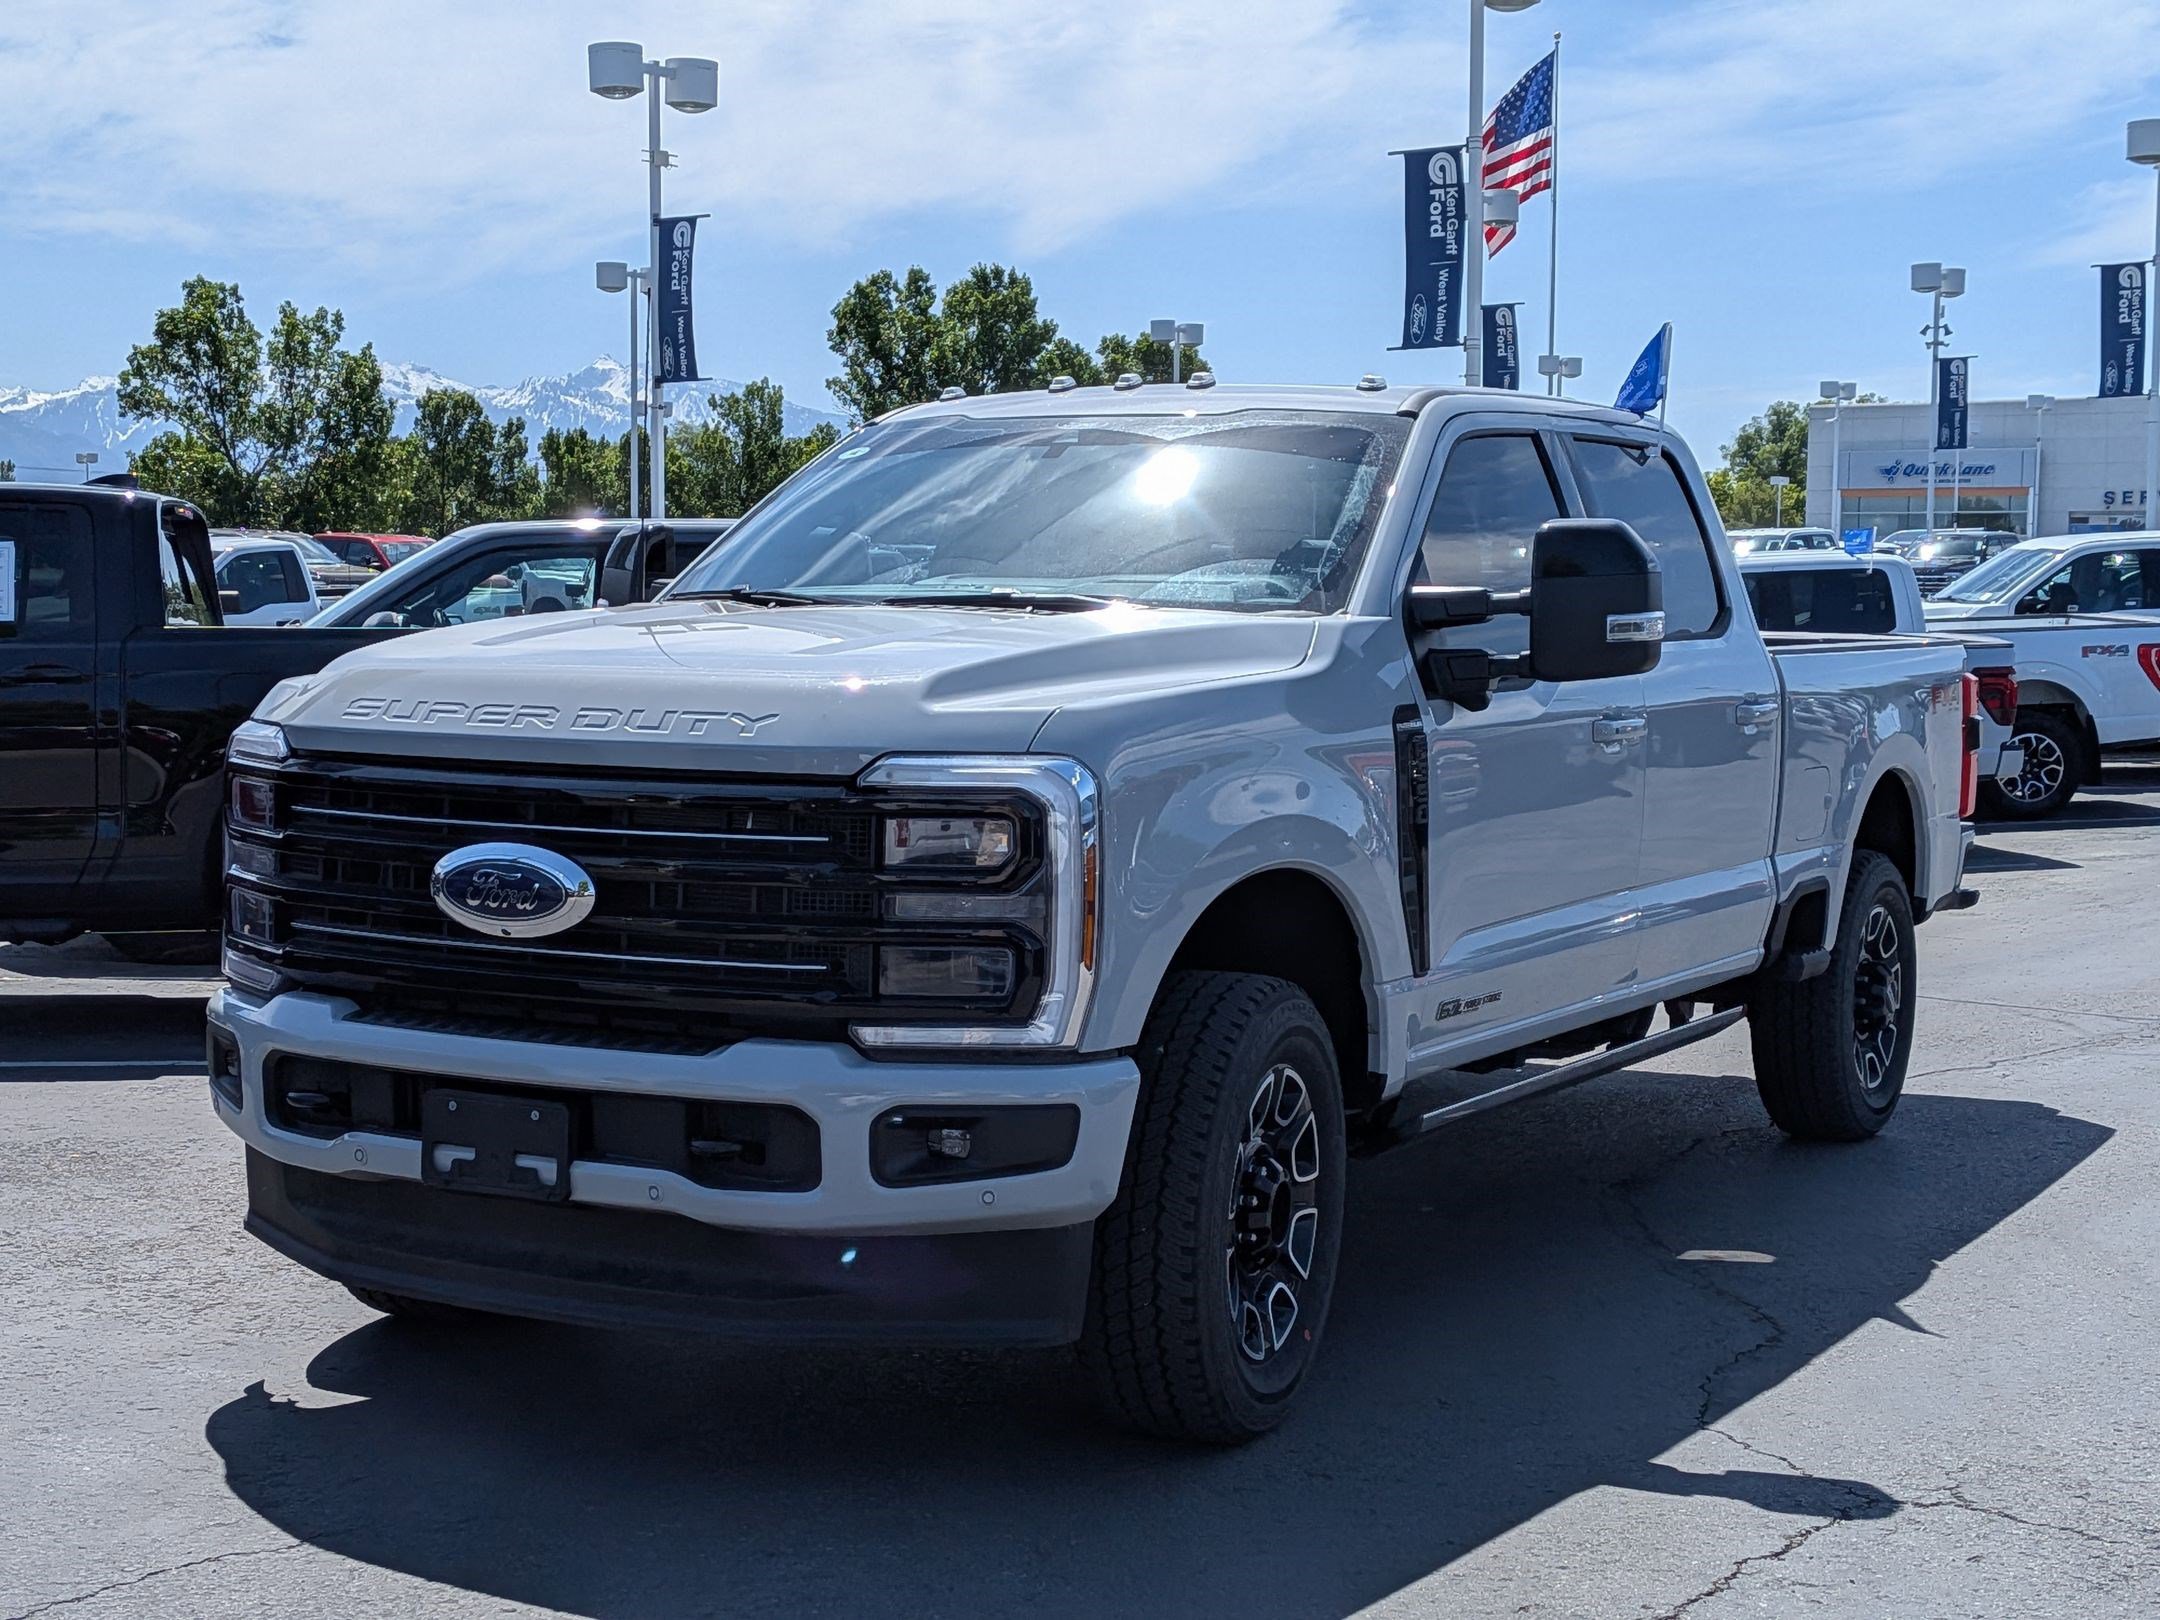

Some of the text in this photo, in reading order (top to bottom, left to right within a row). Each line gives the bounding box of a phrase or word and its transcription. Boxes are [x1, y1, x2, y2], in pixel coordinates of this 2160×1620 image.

[1429, 188, 1446, 238] Ford
[1445, 187, 1458, 256] Ken Garff
[671, 250, 682, 291] Ford
[1433, 268, 1449, 343] West Valley
[2118, 289, 2132, 324] Ford
[1496, 327, 1507, 357] Ford
[2081, 644, 2130, 659] FX4
[341, 697, 782, 737] SUPER DUTY
[465, 868, 541, 911] Ford
